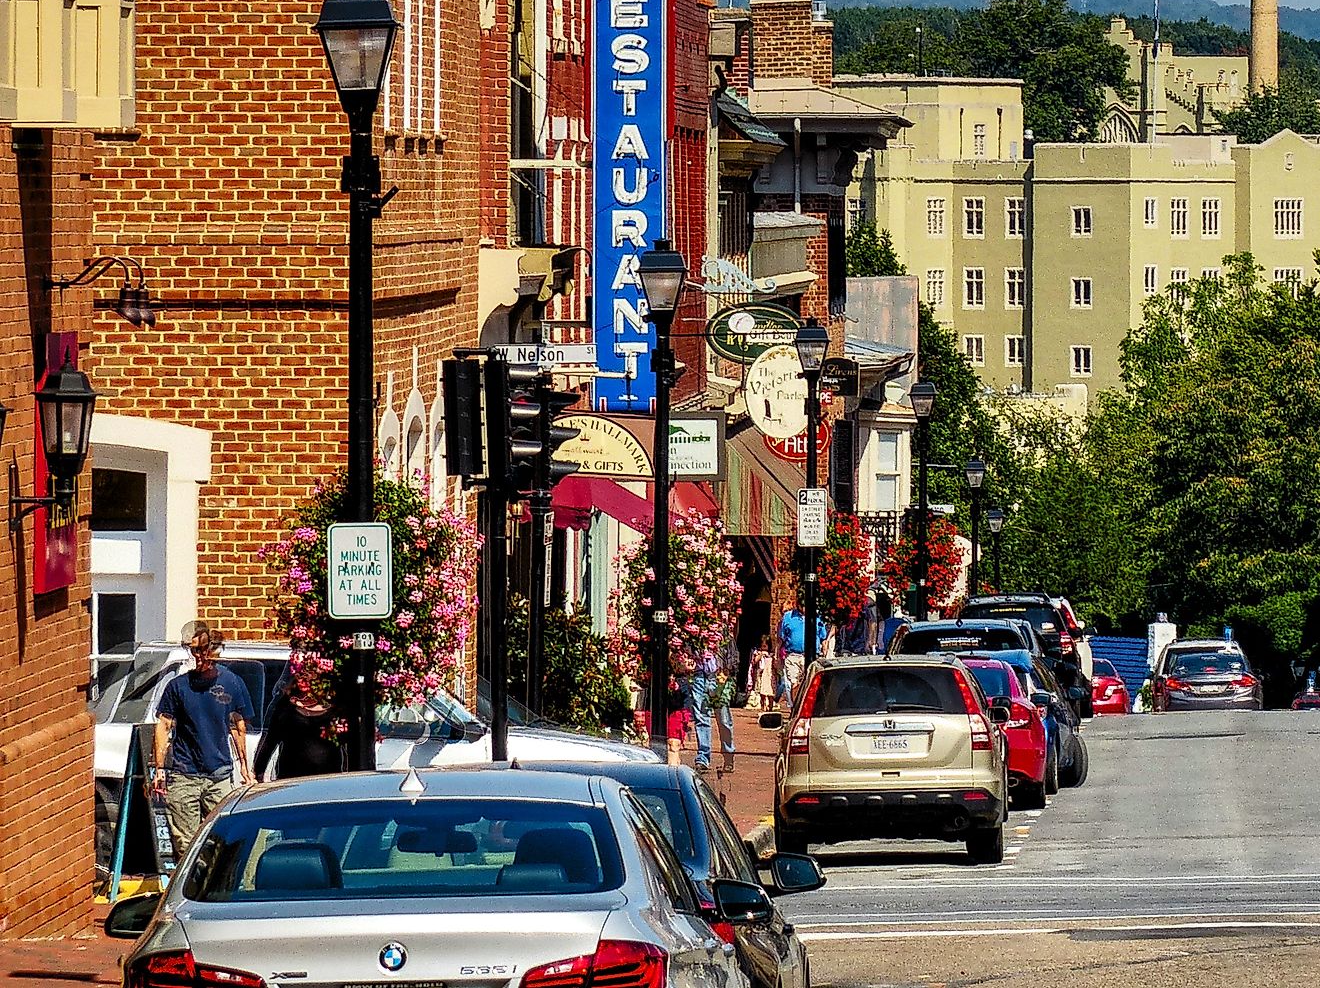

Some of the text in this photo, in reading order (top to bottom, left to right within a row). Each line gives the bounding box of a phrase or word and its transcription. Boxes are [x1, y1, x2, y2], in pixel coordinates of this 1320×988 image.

[517, 347, 564, 362] Nelson
[750, 371, 804, 395] Victoria
[590, 420, 649, 474] HALLMARK
[582, 461, 591, 470] &
[594, 460, 624, 472] GIFTS
[800, 491, 807, 503] 2
[356, 535, 367, 548] 10
[340, 550, 380, 562] MINUTE
[337, 564, 382, 576] PARKING
[339, 579, 381, 591] AT ALL
[347, 593, 378, 606] TIMES
